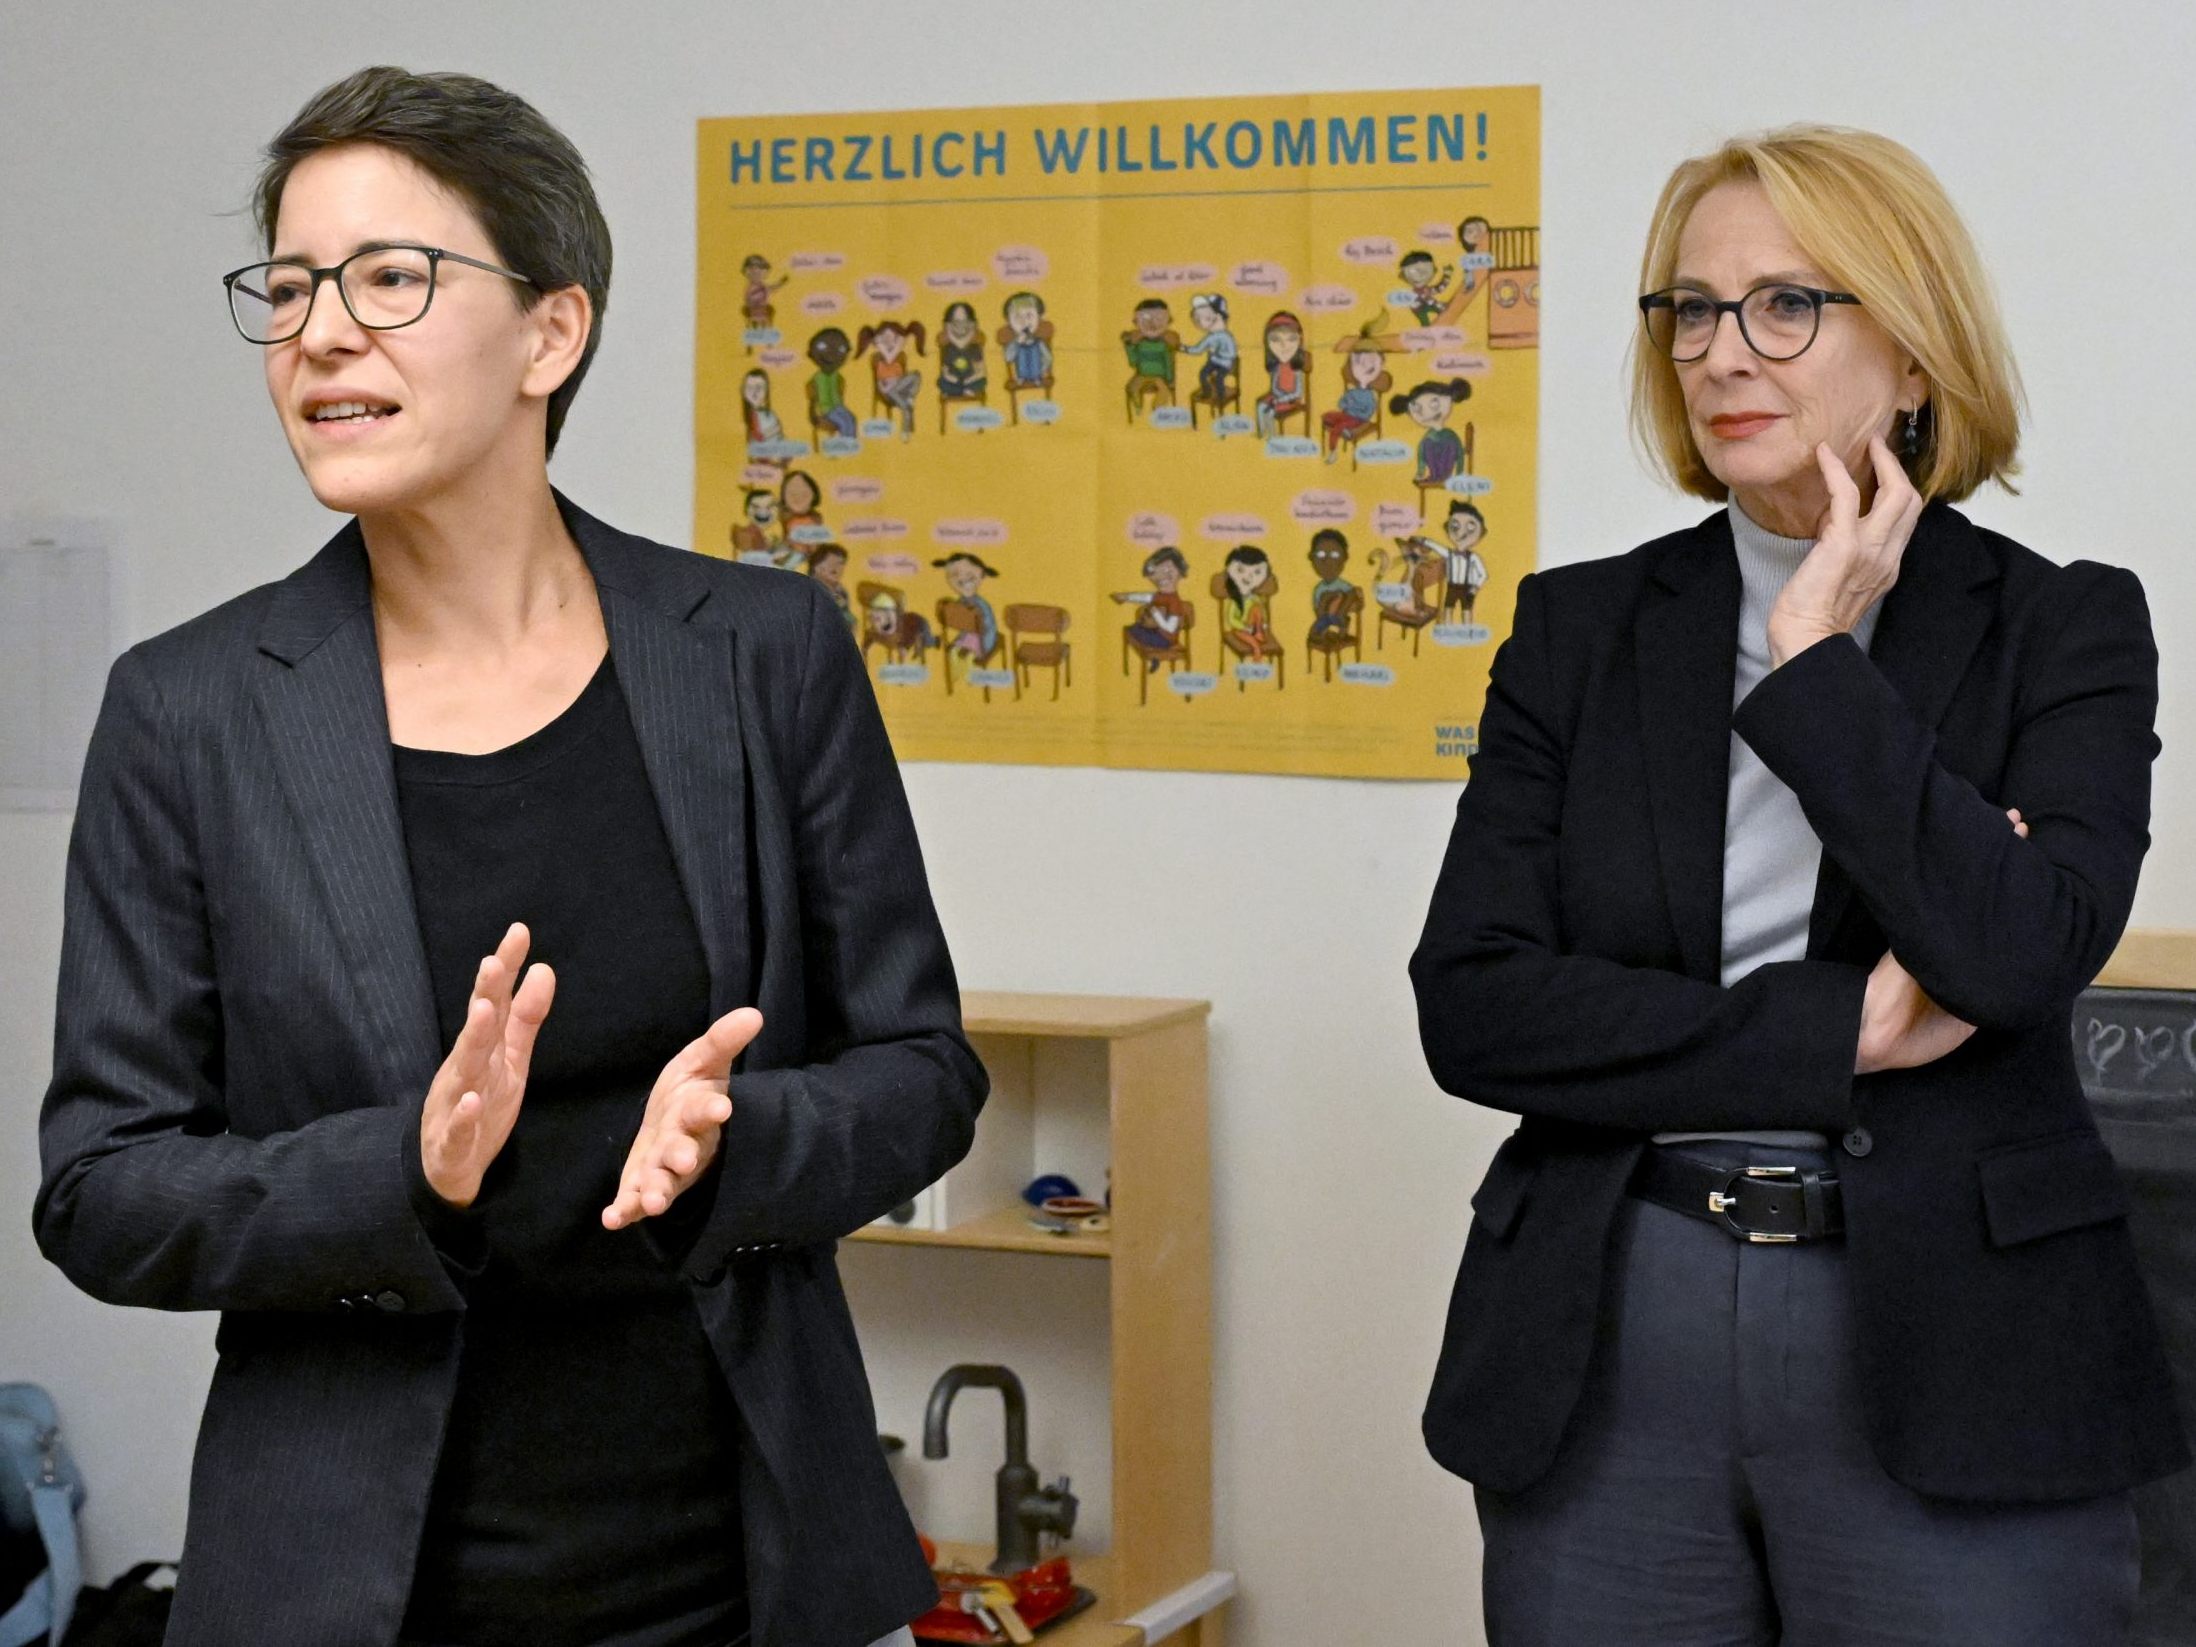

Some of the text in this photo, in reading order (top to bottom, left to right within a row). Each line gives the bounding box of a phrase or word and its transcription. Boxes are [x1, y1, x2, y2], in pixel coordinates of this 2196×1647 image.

[730, 112, 1488, 184] HERZLICH WILLKOMMEN!
[1435, 725, 1475, 740] WAS
